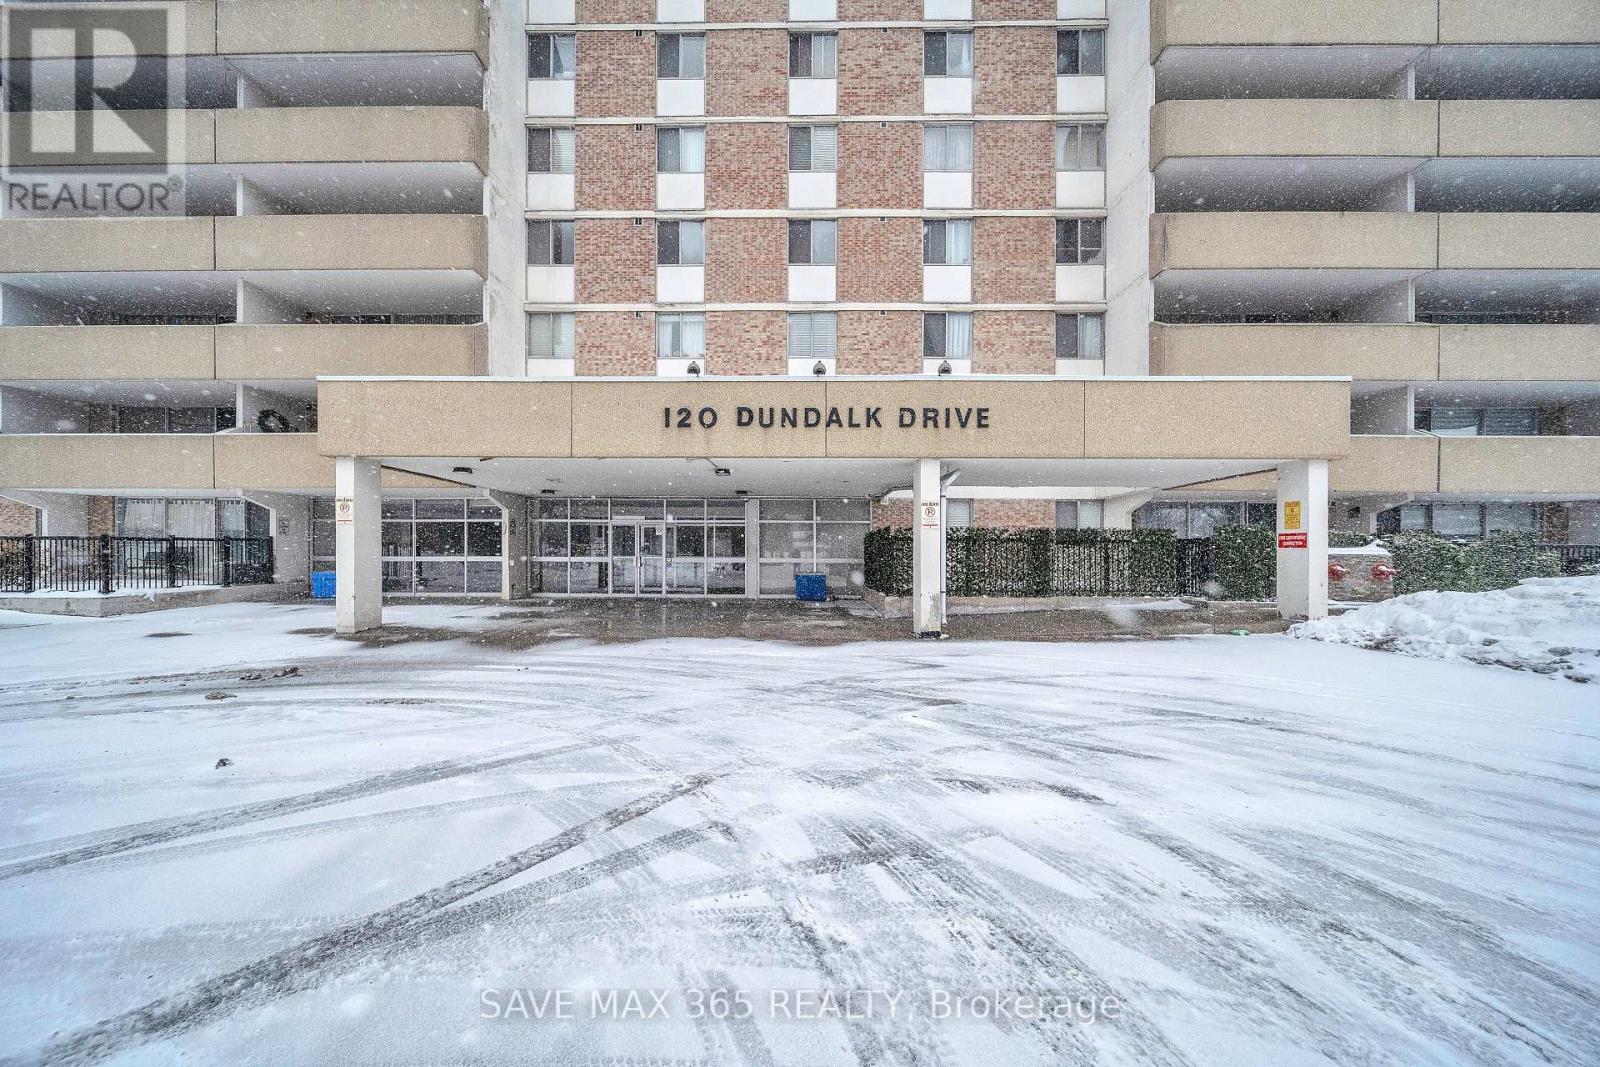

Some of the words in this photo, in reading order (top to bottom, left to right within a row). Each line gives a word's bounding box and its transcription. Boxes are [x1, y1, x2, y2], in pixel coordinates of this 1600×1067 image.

[664, 407, 718, 429] 120
[736, 407, 883, 429] DUNDALK
[899, 407, 990, 429] DRIVE
